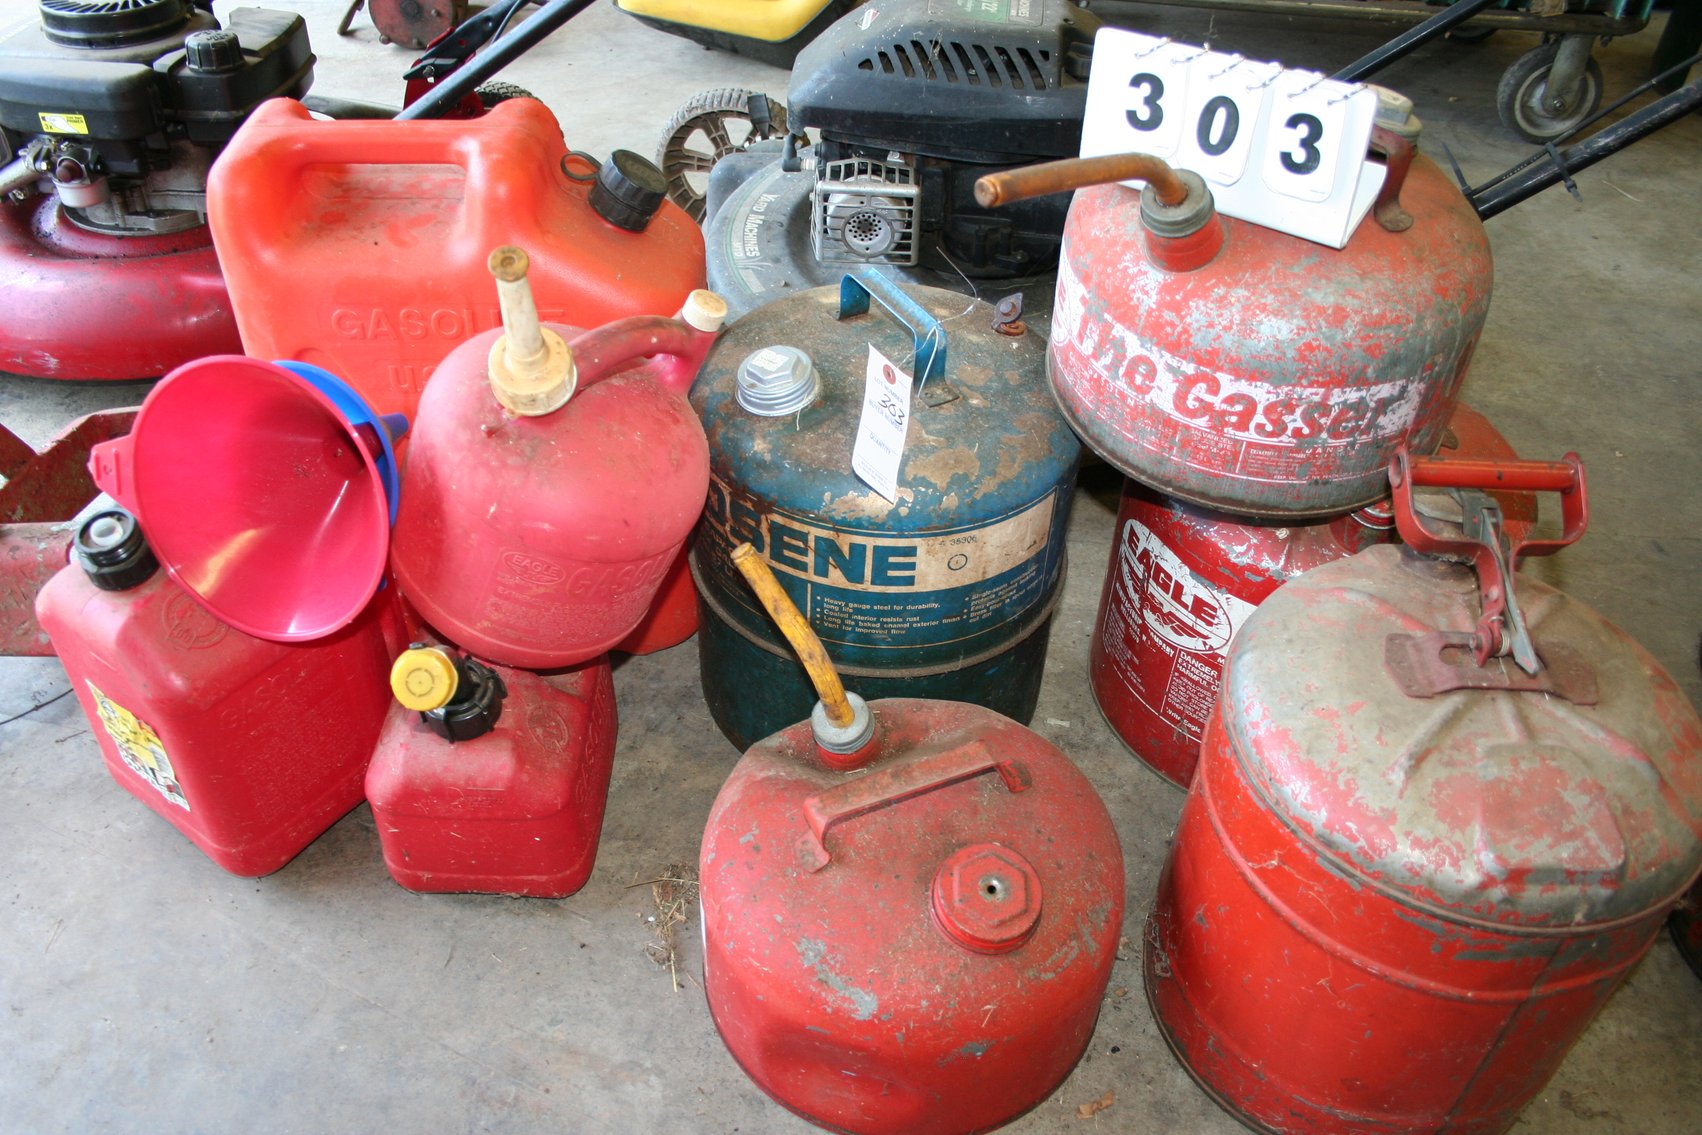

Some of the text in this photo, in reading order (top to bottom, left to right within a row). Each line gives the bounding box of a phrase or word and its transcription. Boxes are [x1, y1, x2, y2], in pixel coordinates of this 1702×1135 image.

[744, 214, 764, 258] MACHINES
[878, 394, 904, 426] 303
[1172, 371, 1405, 440] Gasser
[512, 555, 560, 578] EAGLE
[1126, 522, 1218, 628] EAGLE
[824, 597, 846, 607] Heavy
[848, 602, 870, 610] gauge
[824, 603, 840, 612] long
[824, 608, 848, 618] Coated
[824, 616, 841, 624] Long
[912, 620, 940, 628] exterior
[824, 621, 840, 630] Vent
[1177, 664, 1208, 688] HARMFUL
[1179, 658, 1219, 687] EXTREMELY
[1180, 651, 1218, 678] DANGER
[1192, 698, 1207, 711] STORE
